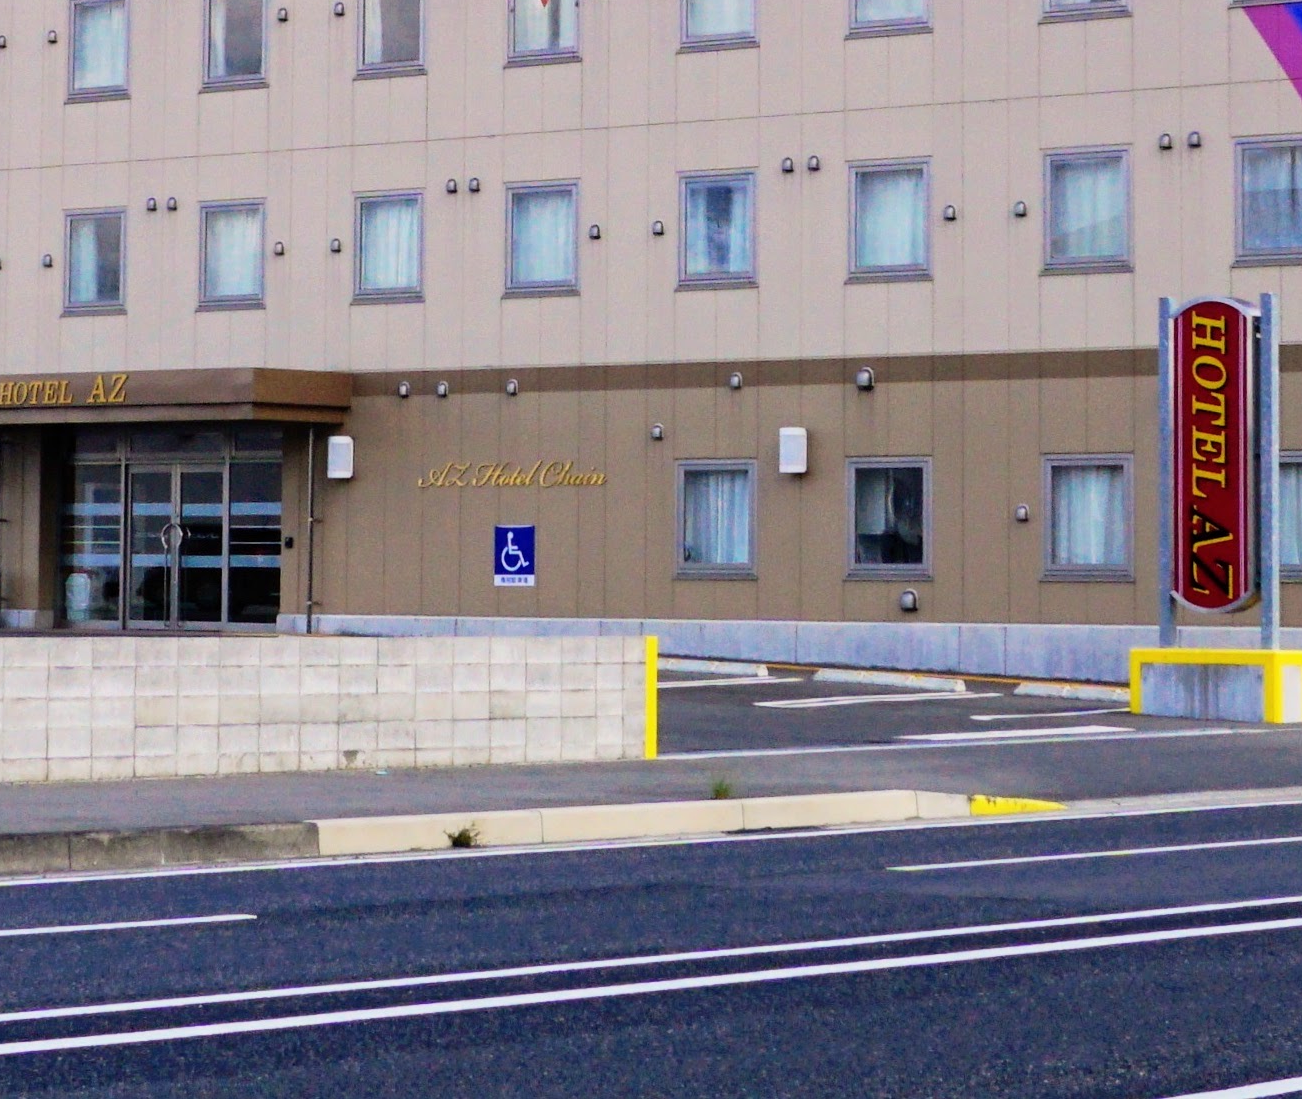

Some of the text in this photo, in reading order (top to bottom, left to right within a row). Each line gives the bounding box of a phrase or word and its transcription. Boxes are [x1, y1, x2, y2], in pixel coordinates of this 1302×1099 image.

[86, 373, 130, 404] AZ
[1191, 310, 1234, 599] HOTEL AZ
[418, 458, 608, 488] AZ Hotel Chain
